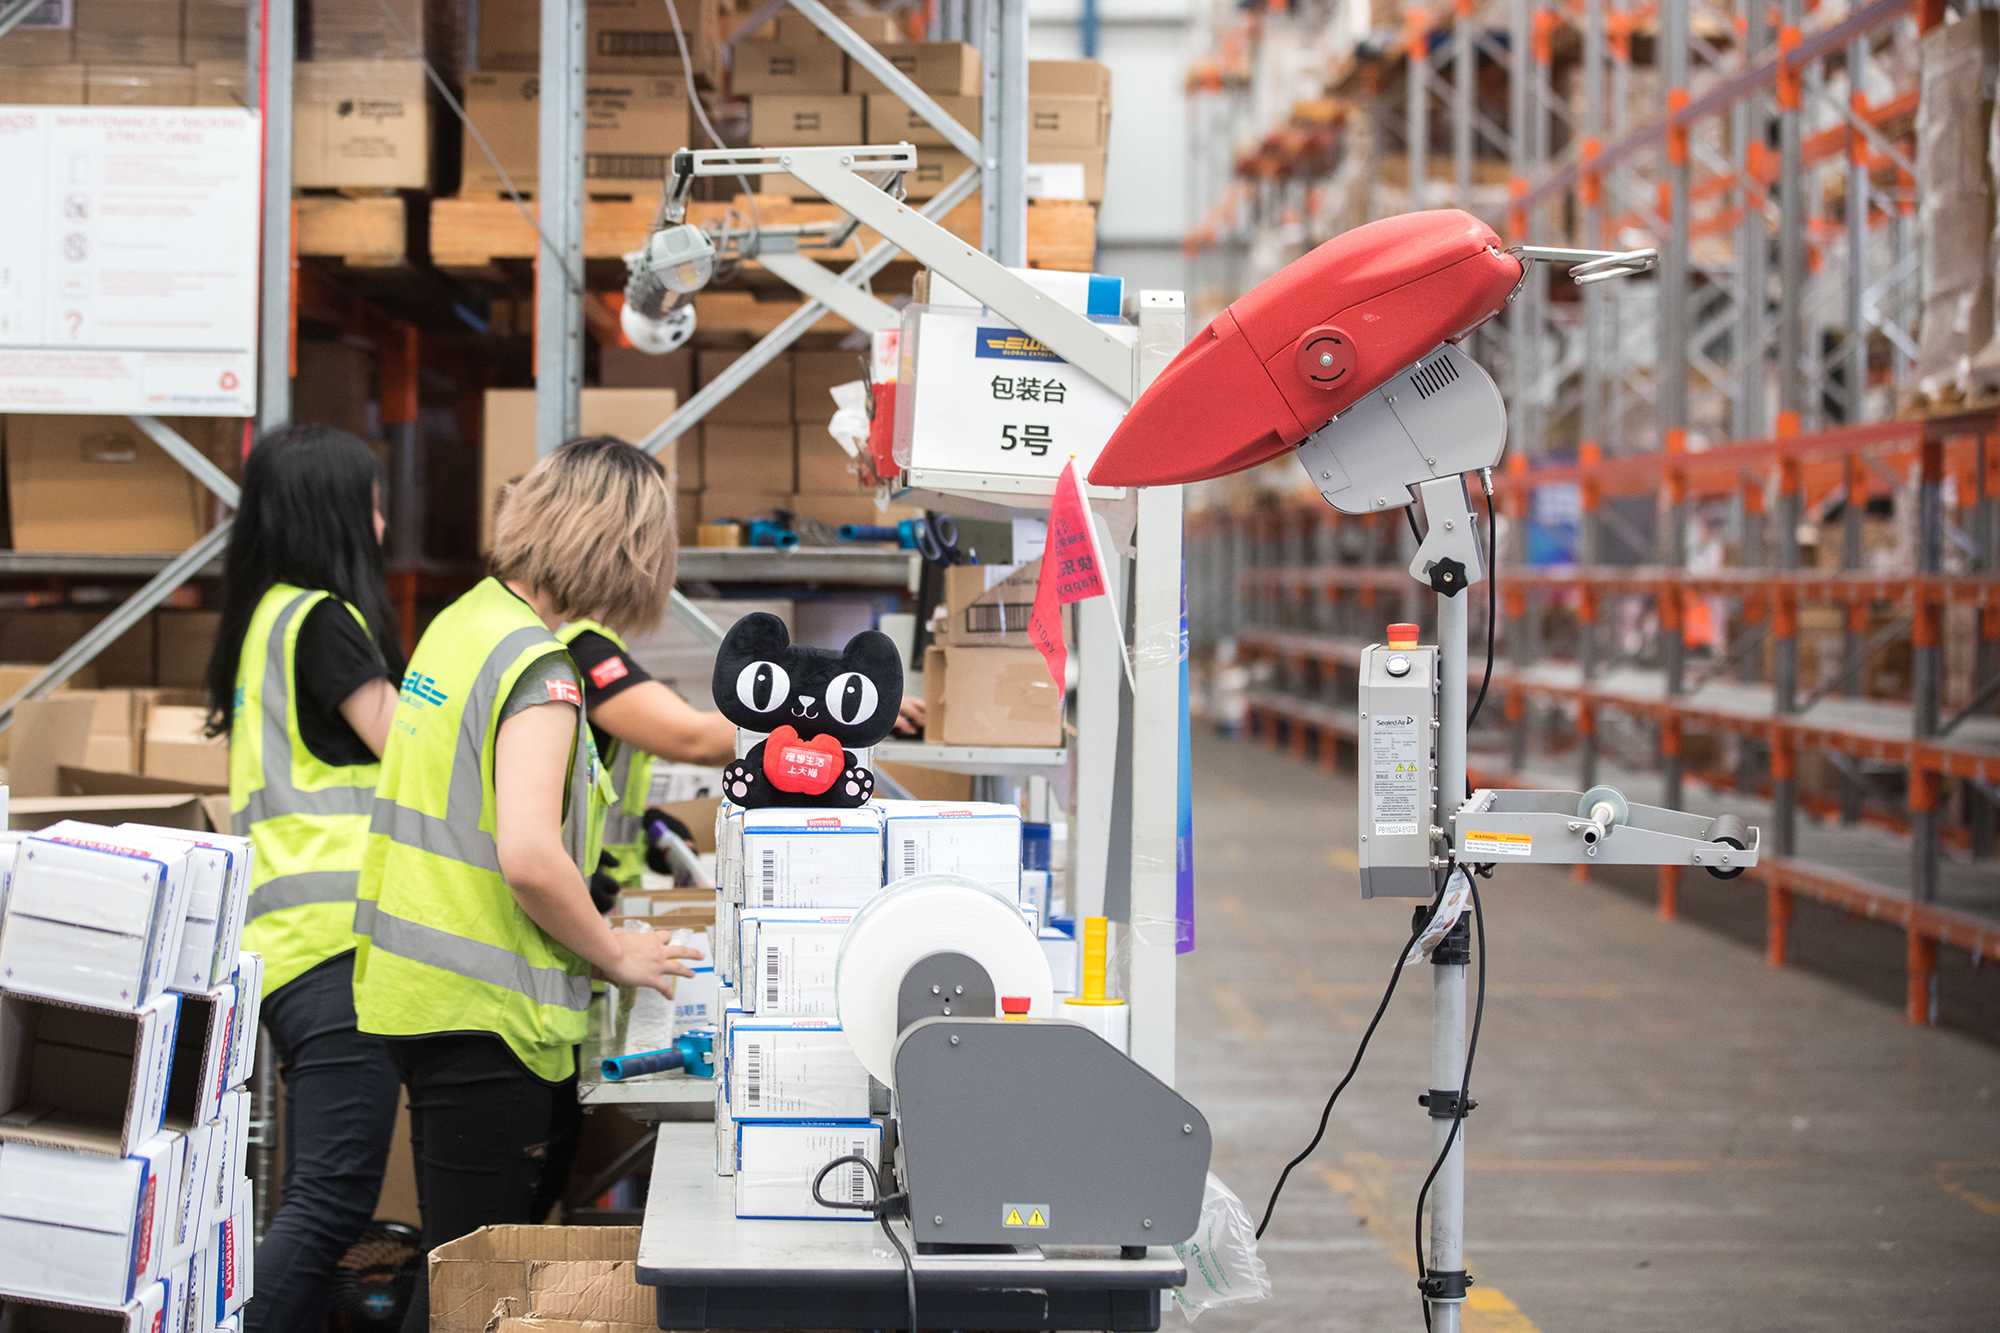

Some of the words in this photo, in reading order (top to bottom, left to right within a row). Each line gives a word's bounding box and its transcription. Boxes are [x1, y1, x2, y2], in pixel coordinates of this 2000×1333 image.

[991, 375, 1067, 404] 包装台
[1001, 424, 1052, 456] 5号
[785, 752, 824, 767] 理想生活
[788, 765, 818, 778] 上天猫
